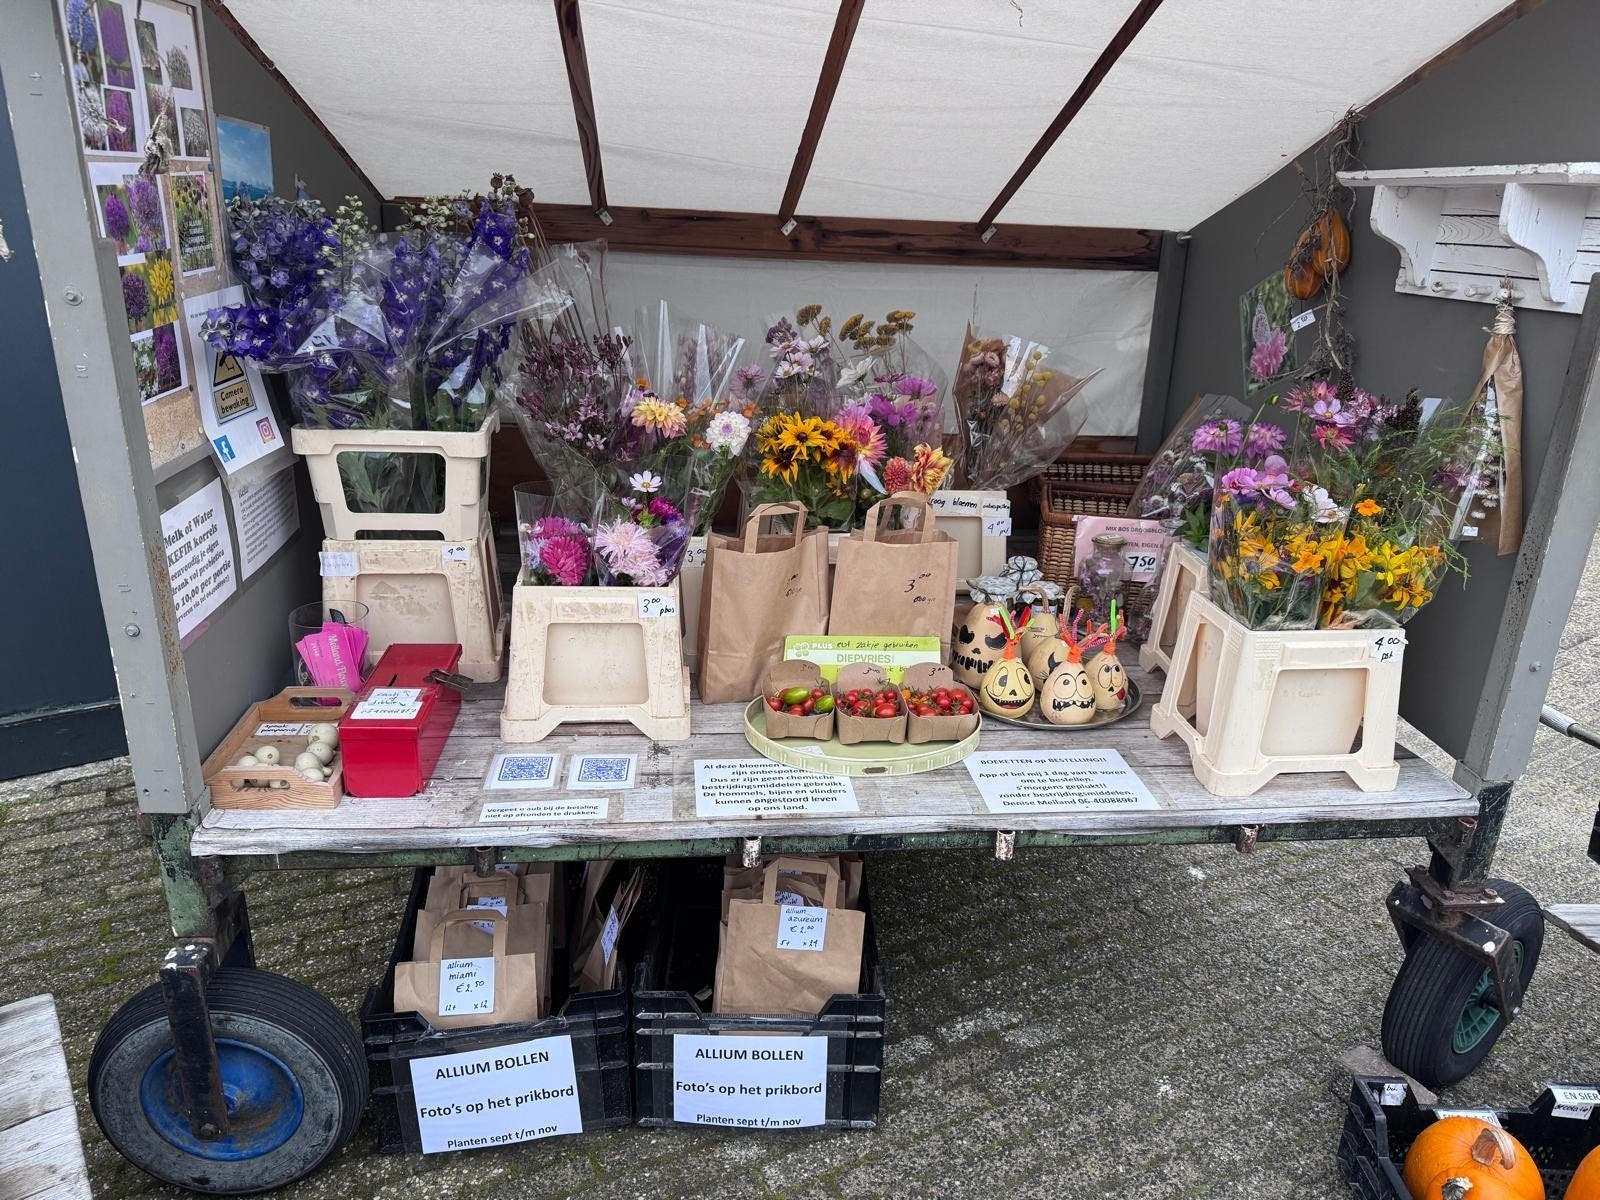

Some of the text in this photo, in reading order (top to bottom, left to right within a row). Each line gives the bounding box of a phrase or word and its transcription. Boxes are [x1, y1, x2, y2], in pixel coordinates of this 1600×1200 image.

[220, 386, 244, 401] Camera
[220, 396, 250, 415] bewaking
[928, 496, 946, 508] roog
[952, 496, 978, 508] bloemen
[164, 508, 214, 549] Melk of Water
[167, 523, 218, 568] KEFIR korrels
[181, 586, 200, 612] 10,00
[200, 579, 213, 596] per
[212, 559, 232, 584] portie
[1033, 790, 1134, 798] bestrijdingsmiddelen.
[447, 960, 473, 969] allium
[448, 968, 477, 980] miami
[695, 1048, 804, 1061] ALLIUM BOLLEN
[435, 1051, 550, 1080] ALLIUM BOLLEN
[676, 1080, 822, 1098] Foto's op het prikbord
[1563, 1092, 1578, 1100] EN
[420, 1084, 575, 1119] Foto's op het prikbord
[696, 1114, 802, 1128] Planten sept t/m nov
[447, 1124, 558, 1149] Planten sept t/m nov
